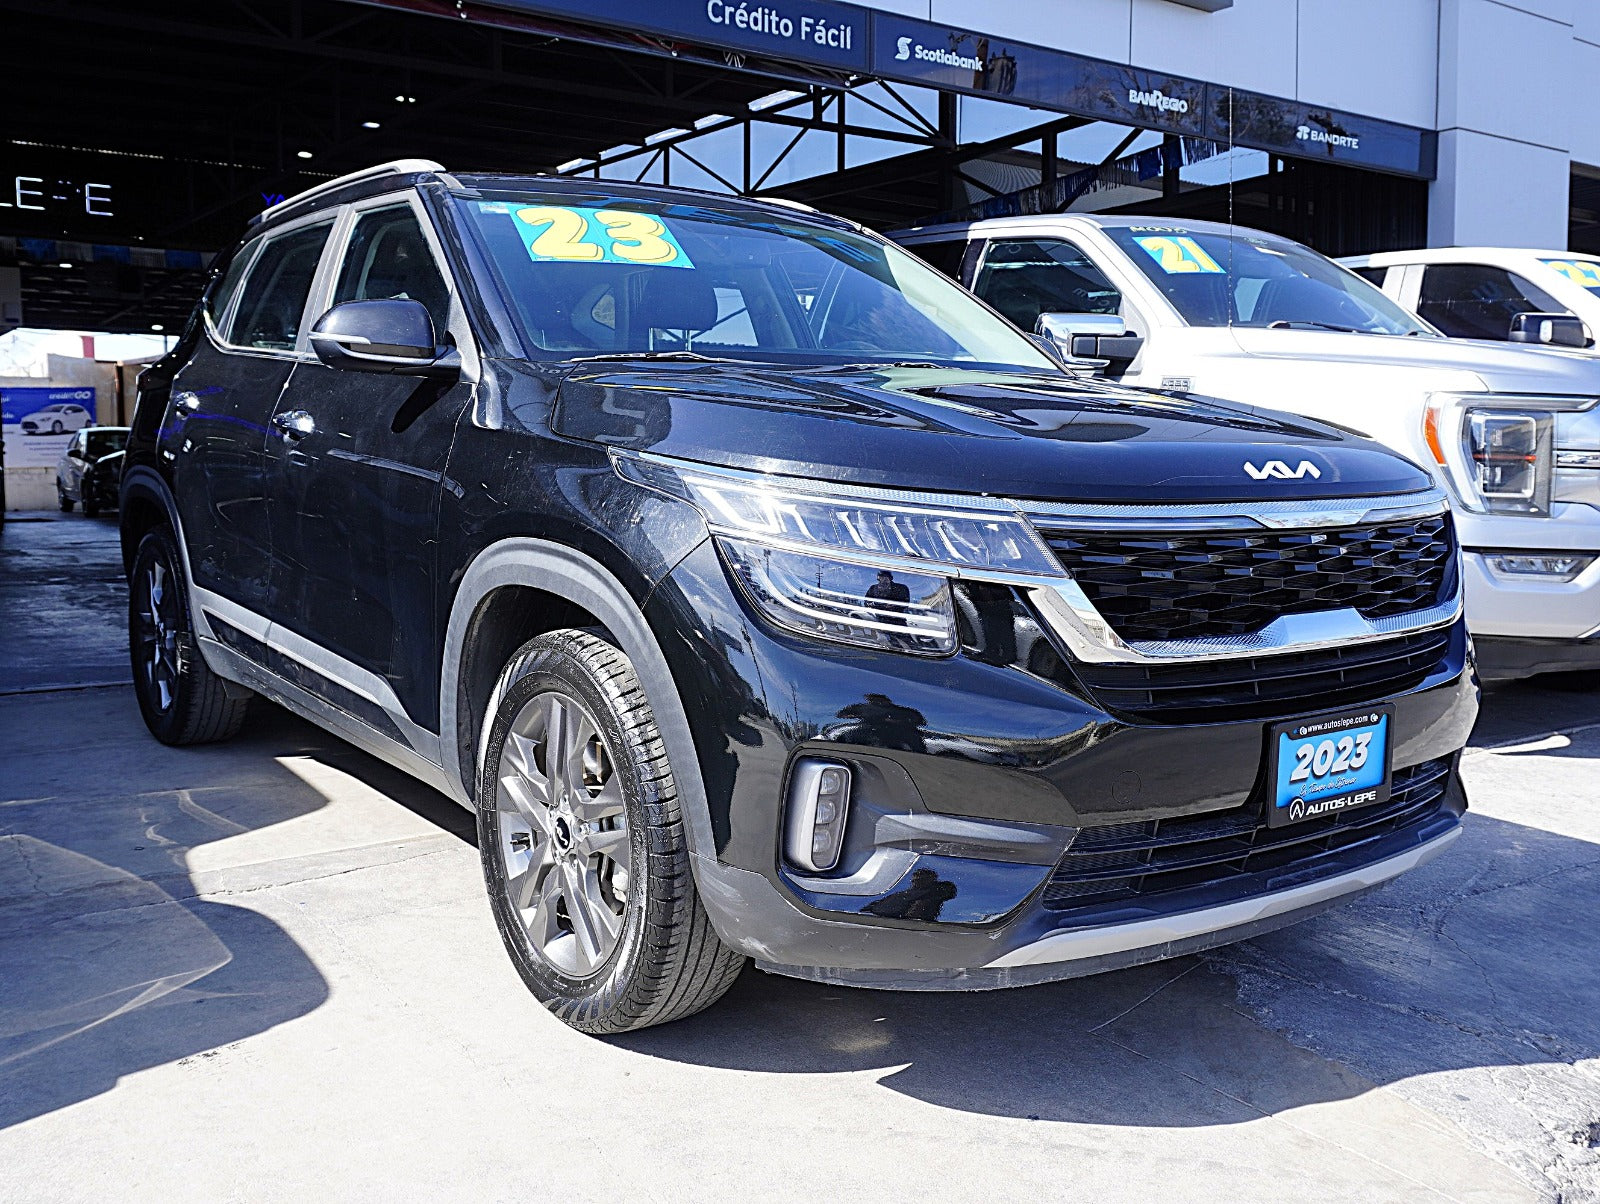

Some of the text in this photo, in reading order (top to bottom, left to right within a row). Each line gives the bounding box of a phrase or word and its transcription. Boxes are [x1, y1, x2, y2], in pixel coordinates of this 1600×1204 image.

[707, 0, 852, 50] Crédito Fácil
[914, 44, 983, 71] Scotiabank
[1310, 130, 1359, 149] BANORTE
[515, 206, 679, 264] 23
[1140, 236, 1221, 272] 21
[1307, 714, 1369, 733] www.autoslepe.com
[1290, 731, 1373, 783] 2023
